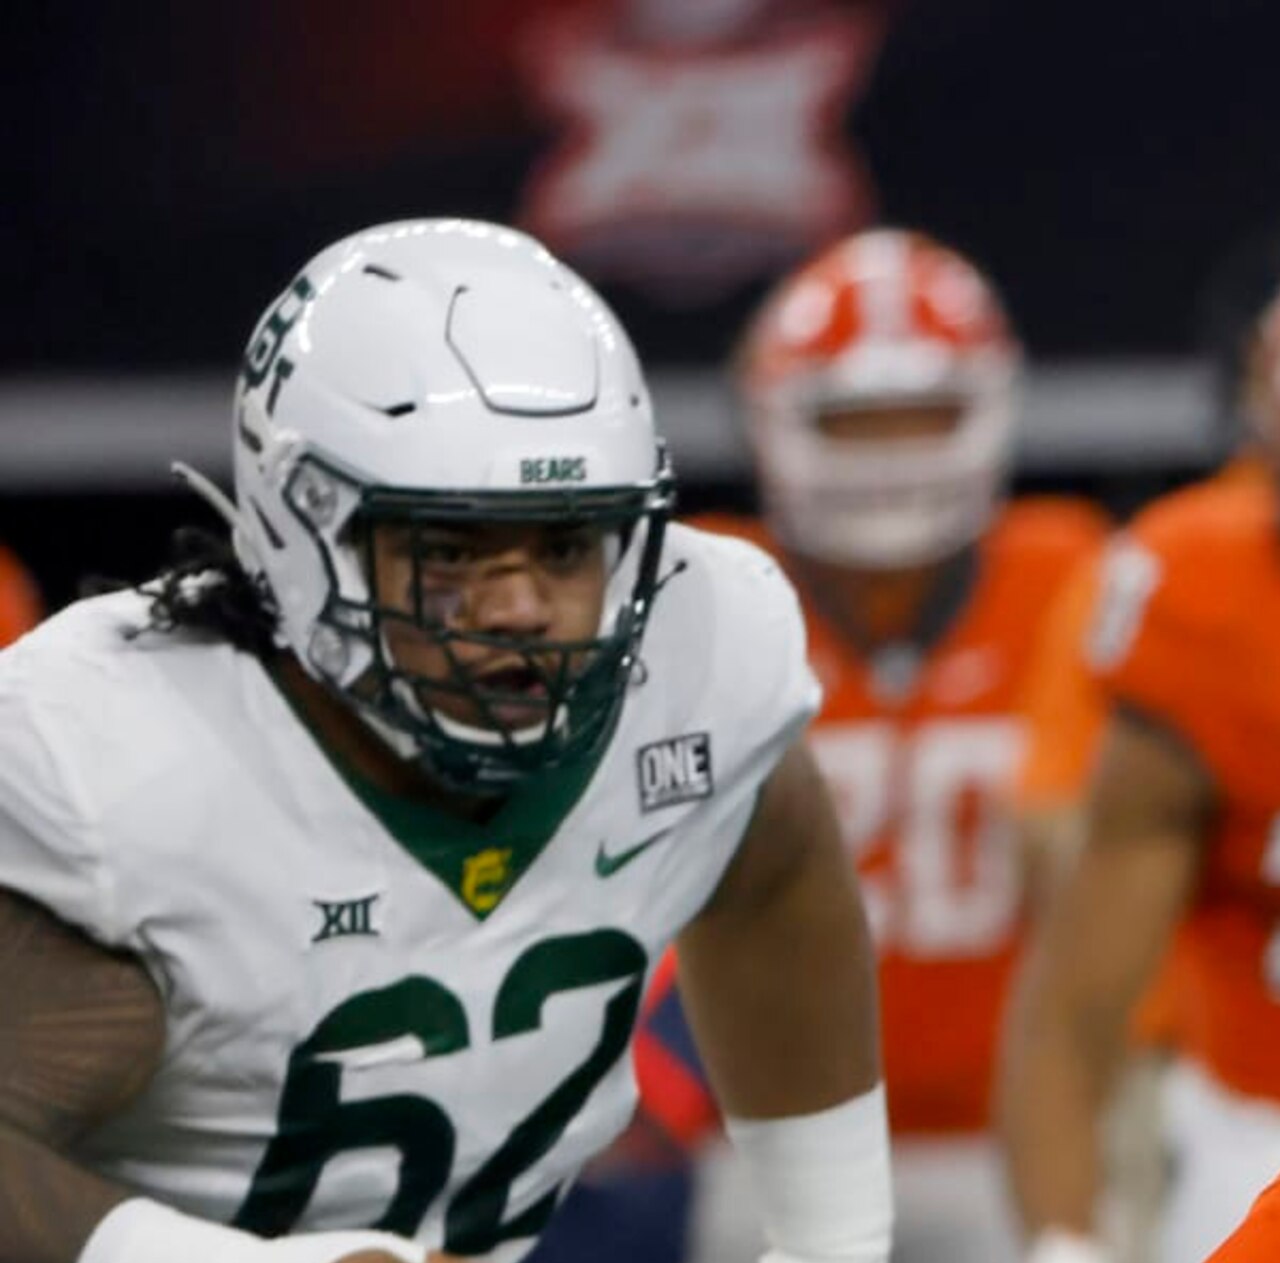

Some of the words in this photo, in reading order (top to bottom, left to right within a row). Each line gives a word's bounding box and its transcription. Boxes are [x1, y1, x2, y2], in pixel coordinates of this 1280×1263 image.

[519, 459, 587, 483] BEARS
[642, 738, 707, 792] ONE
[312, 893, 380, 942] XII
[230, 928, 648, 1255] 62
